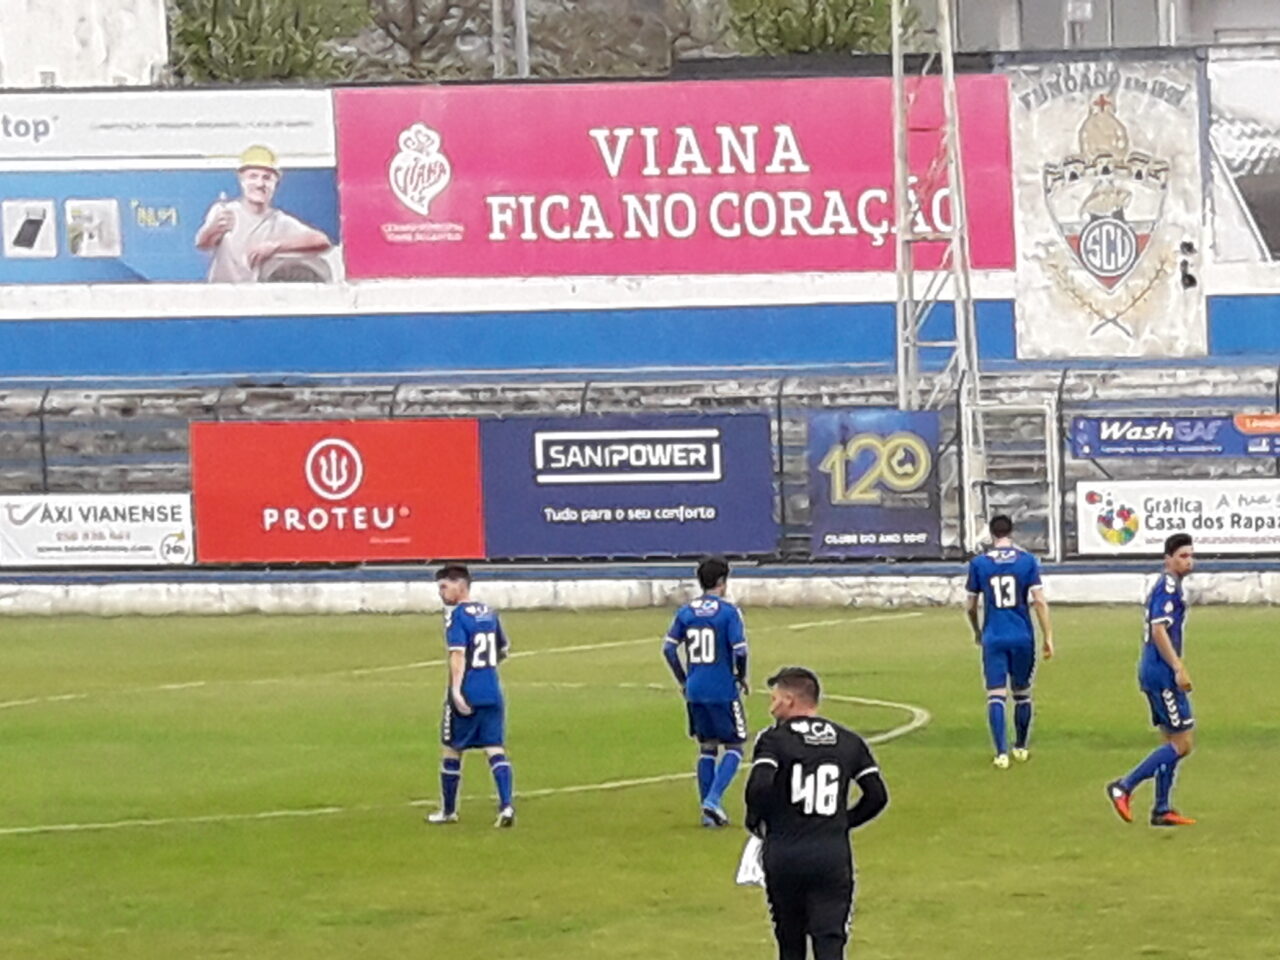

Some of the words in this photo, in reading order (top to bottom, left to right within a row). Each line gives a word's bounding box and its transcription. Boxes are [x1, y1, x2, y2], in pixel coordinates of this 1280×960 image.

[588, 124, 811, 179] VIANA
[487, 193, 614, 241] FICA
[622, 191, 698, 240] NO
[549, 443, 707, 468] SANIPOWER
[78, 504, 183, 524] VIANENSE
[263, 506, 395, 532] PROTEU
[543, 506, 578, 521] Tudo
[1143, 496, 1203, 514] Gráfica
[1144, 513, 1186, 530] Casa
[1192, 513, 1225, 530] dos
[989, 575, 1017, 609] 13
[472, 632, 497, 669] 21
[686, 627, 716, 664] 20
[791, 763, 840, 817] 46
